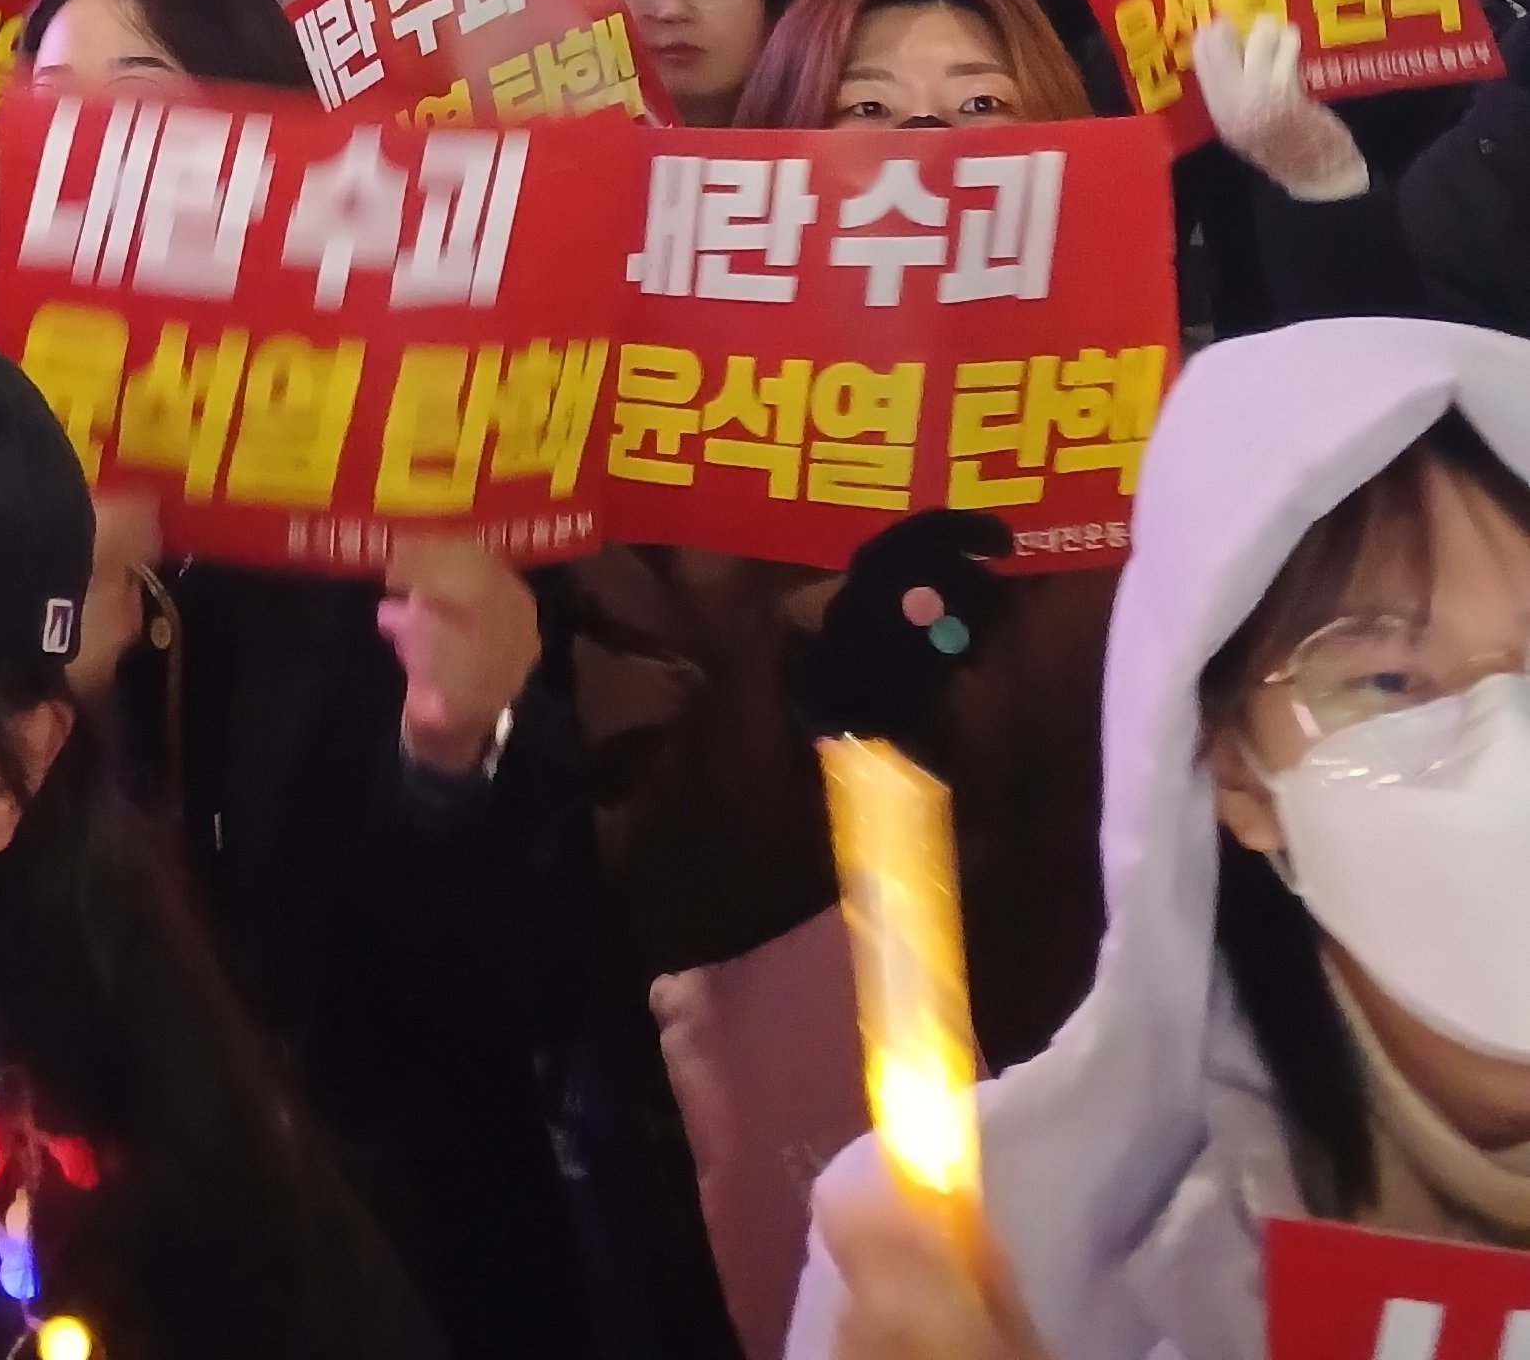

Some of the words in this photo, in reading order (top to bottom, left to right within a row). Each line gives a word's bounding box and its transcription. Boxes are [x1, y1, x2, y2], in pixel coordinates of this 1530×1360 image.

[19, 99, 274, 302] 내란
[282, 123, 532, 312] 수괴
[830, 149, 1068, 309] 수괴
[21, 298, 364, 511] 윤석열
[374, 336, 610, 518] 탄핵
[607, 342, 925, 513] 윤석열
[945, 344, 1170, 512] 탄핵
